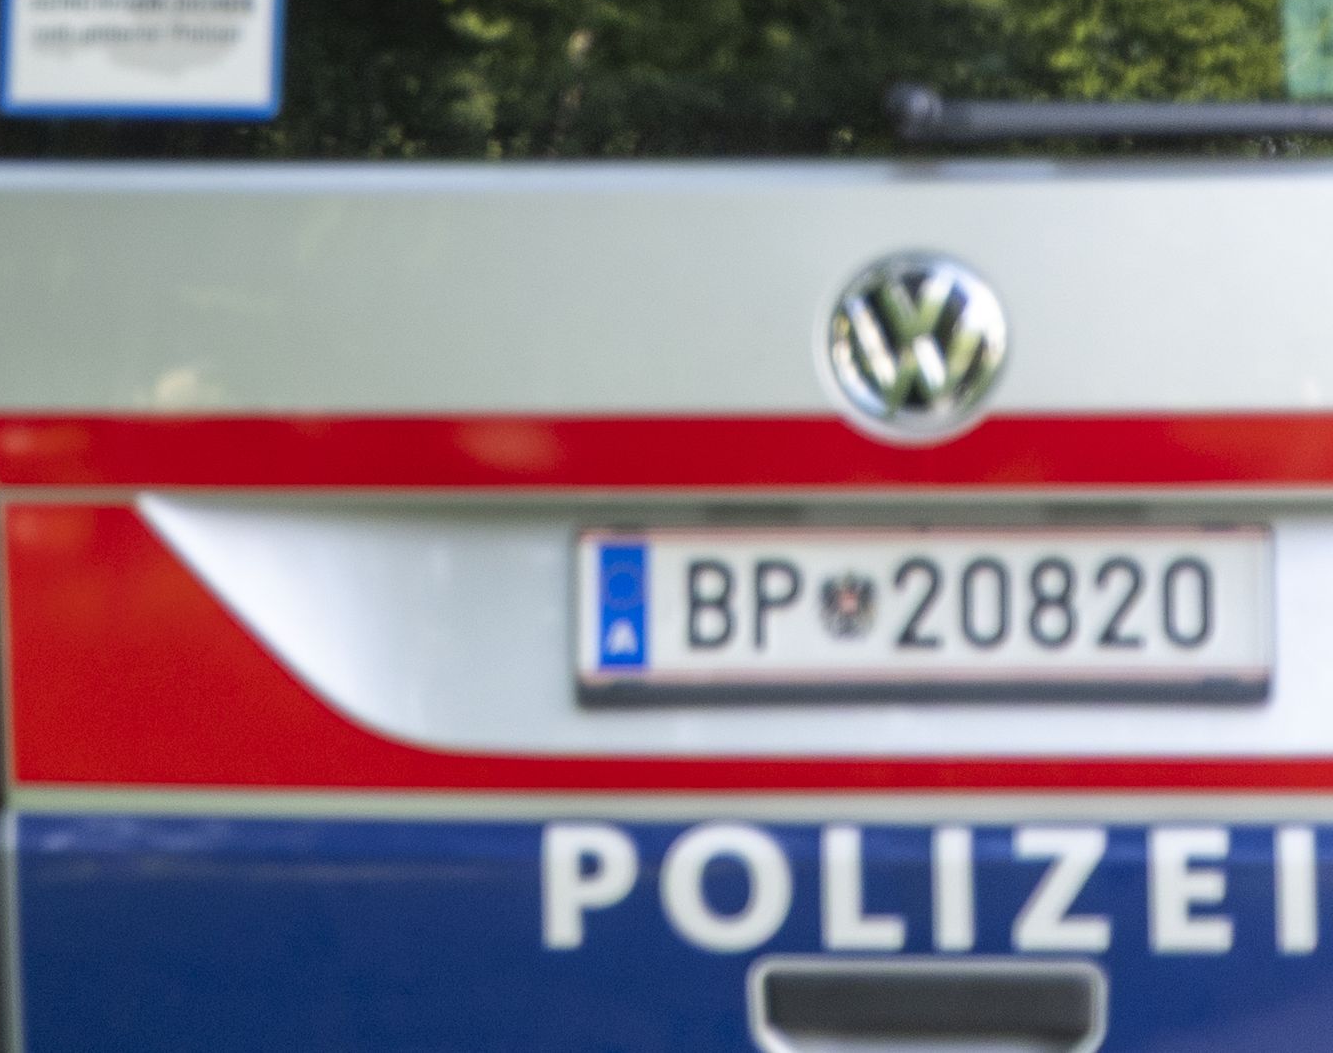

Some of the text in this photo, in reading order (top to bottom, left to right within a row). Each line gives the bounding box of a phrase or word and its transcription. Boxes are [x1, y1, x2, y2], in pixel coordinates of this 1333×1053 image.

[687, 556, 1217, 653] BP 20820
[541, 822, 1318, 954] POLIZEI
